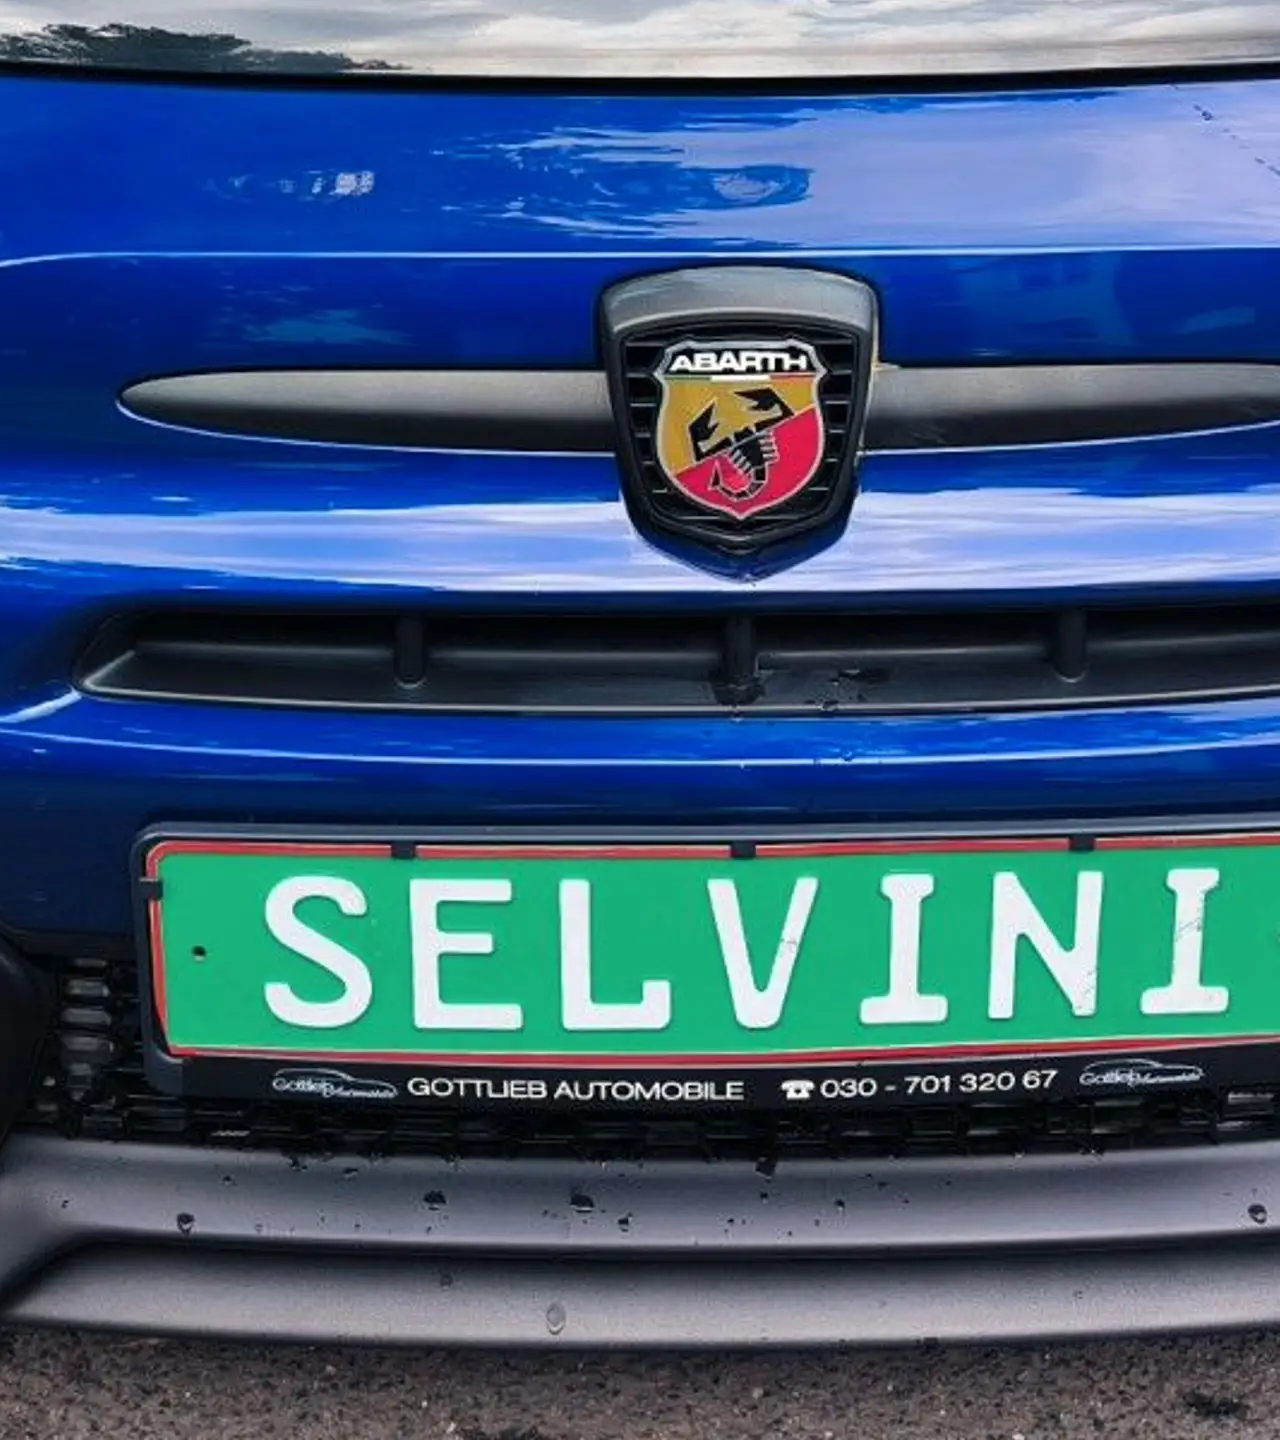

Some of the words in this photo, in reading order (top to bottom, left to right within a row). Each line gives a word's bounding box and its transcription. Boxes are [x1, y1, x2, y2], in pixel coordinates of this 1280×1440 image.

[670, 351, 807, 371] ABARTH
[263, 868, 1230, 1030] SELVINI
[407, 1077, 548, 1099] GOTTLIEB
[553, 1080, 745, 1101] AUTOMOBILE
[820, 1078, 878, 1098] 030
[904, 1074, 951, 1094] 701
[959, 1071, 1017, 1092] 320
[1022, 1069, 1059, 1089] 67
